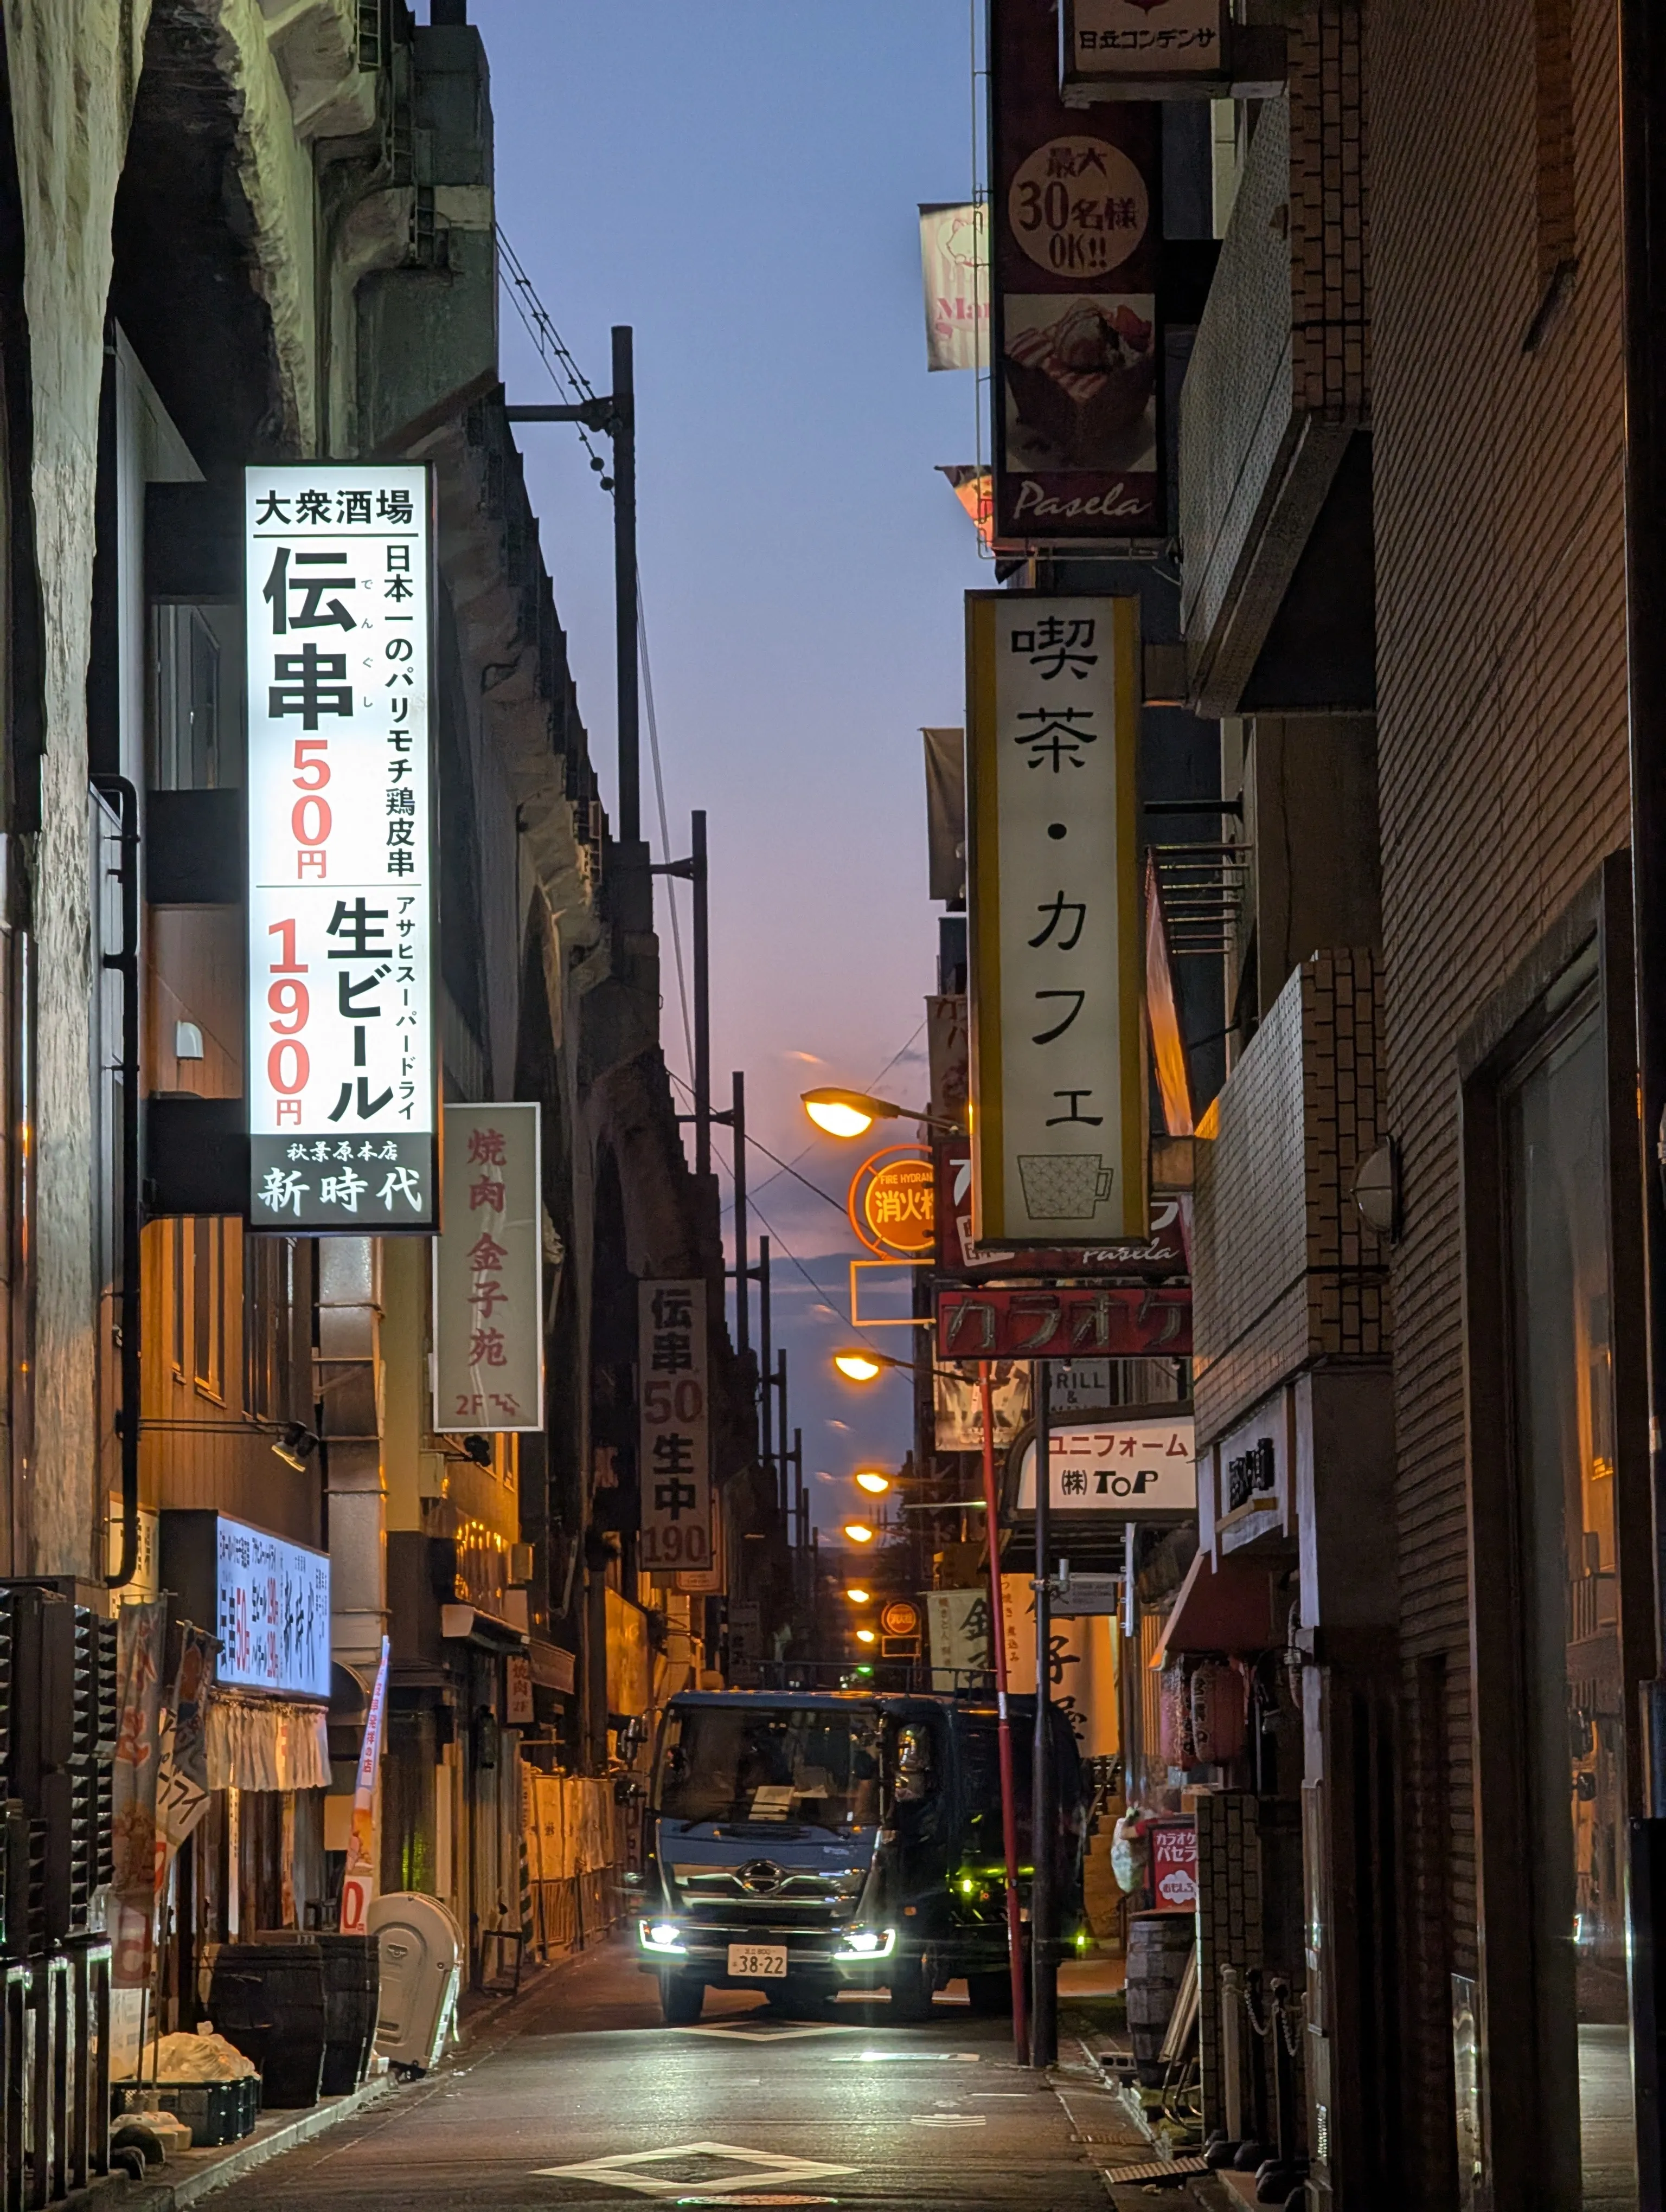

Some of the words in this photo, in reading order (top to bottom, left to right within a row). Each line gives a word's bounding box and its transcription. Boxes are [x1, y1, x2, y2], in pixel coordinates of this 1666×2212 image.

[1079, 28, 1215, 49] 日立コンデンサ
[1046, 147, 1107, 177] 最大
[1018, 181, 1136, 231] 30名様
[1049, 234, 1107, 268] OK!!
[255, 489, 414, 525] 大衆酒場
[1013, 480, 1152, 520] Pasela
[262, 546, 357, 730] 伝串
[361, 579, 374, 708] でんぐし
[384, 544, 415, 877] 日本一のパリモチ鶏皮串
[291, 739, 332, 879] 50円
[1011, 615, 1103, 1126] 喫茶・カフェ
[267, 918, 310, 1126] 190円
[326, 897, 394, 1122] 生ビール
[396, 896, 417, 1120] アサヒスーパードライ
[286, 1141, 398, 1163] 秋葉原本店
[257, 1167, 422, 1217] 新時代
[881, 1174, 898, 1185] FIRE
[901, 1172, 933, 1184] HYDRAN
[652, 1288, 691, 1374] 伝串
[942, 1290, 1192, 1352] カラオケ
[644, 1379, 702, 1424] 50
[1050, 1372, 1105, 1389] RILL
[1049, 1434, 1188, 1457] ユニフォーム
[653, 1433, 695, 1520] 生中
[739, 1956, 783, 1974] 38-22
